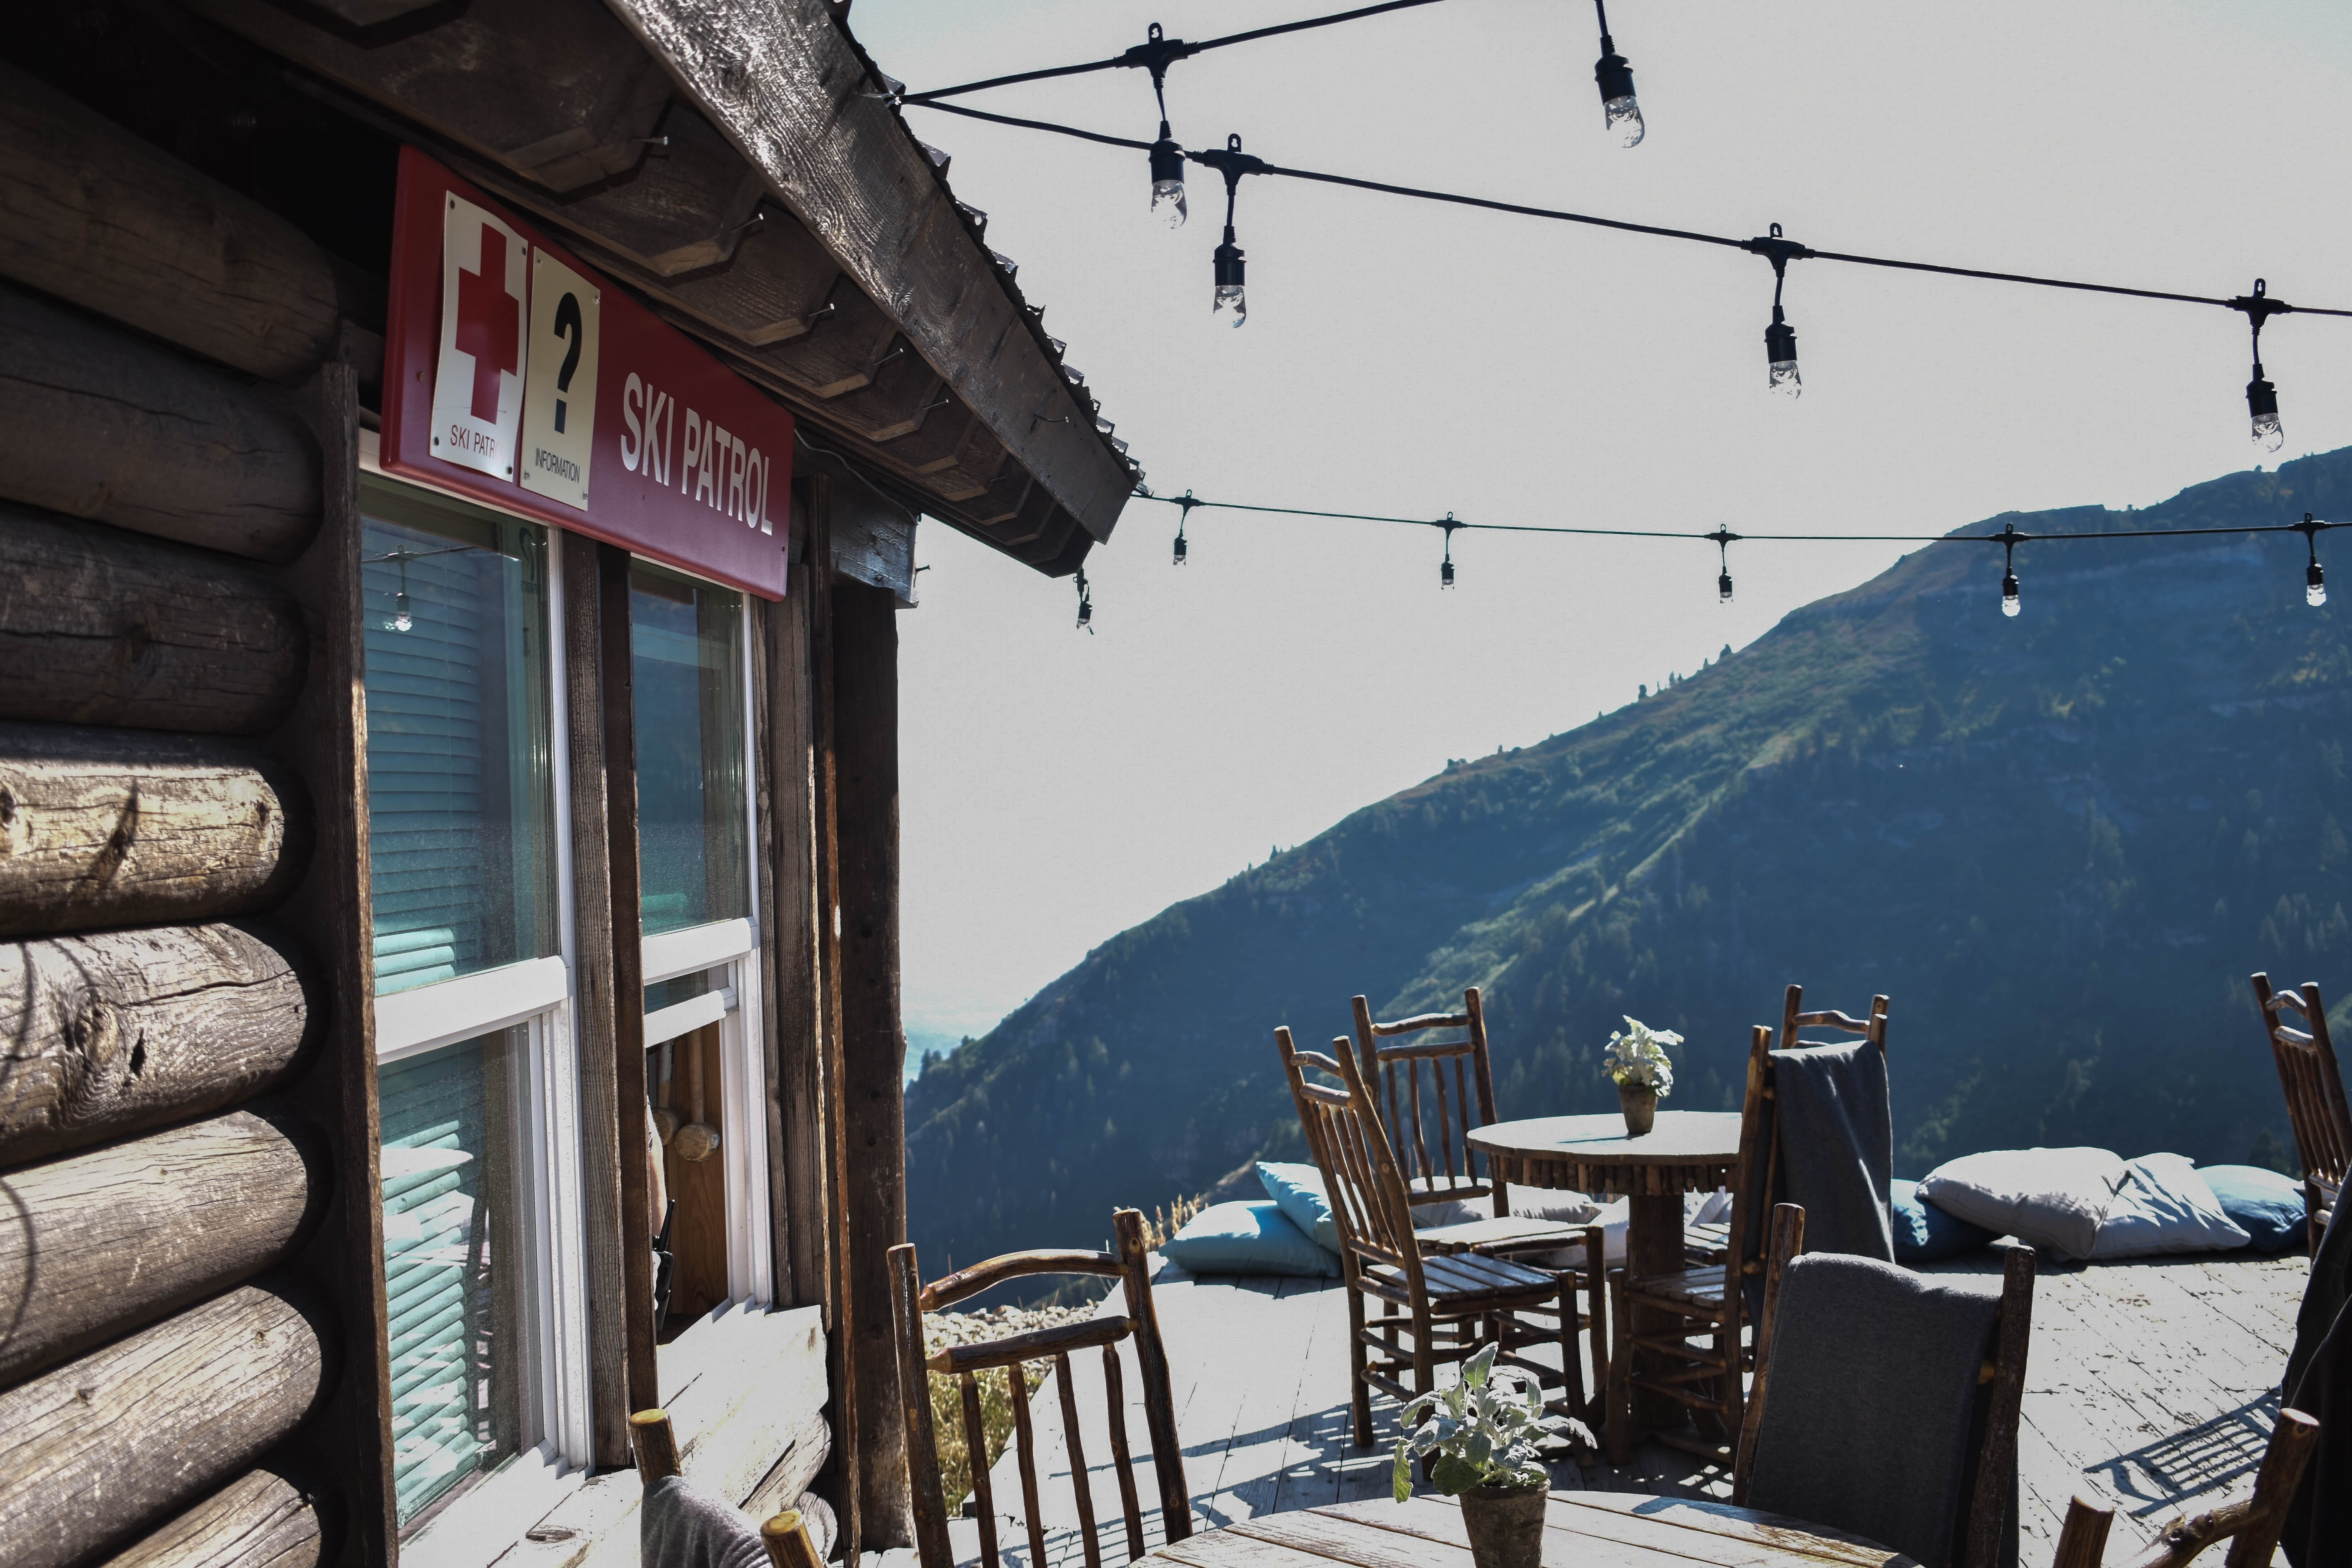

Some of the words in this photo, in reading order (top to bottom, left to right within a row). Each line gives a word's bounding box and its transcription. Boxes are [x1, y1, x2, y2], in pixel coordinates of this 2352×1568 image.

[450, 424, 470, 450] SKI
[474, 432, 503, 463] PATR
[621, 372, 674, 487] SKI
[682, 407, 773, 536] PATROL
[535, 447, 580, 483] INFORMATION
